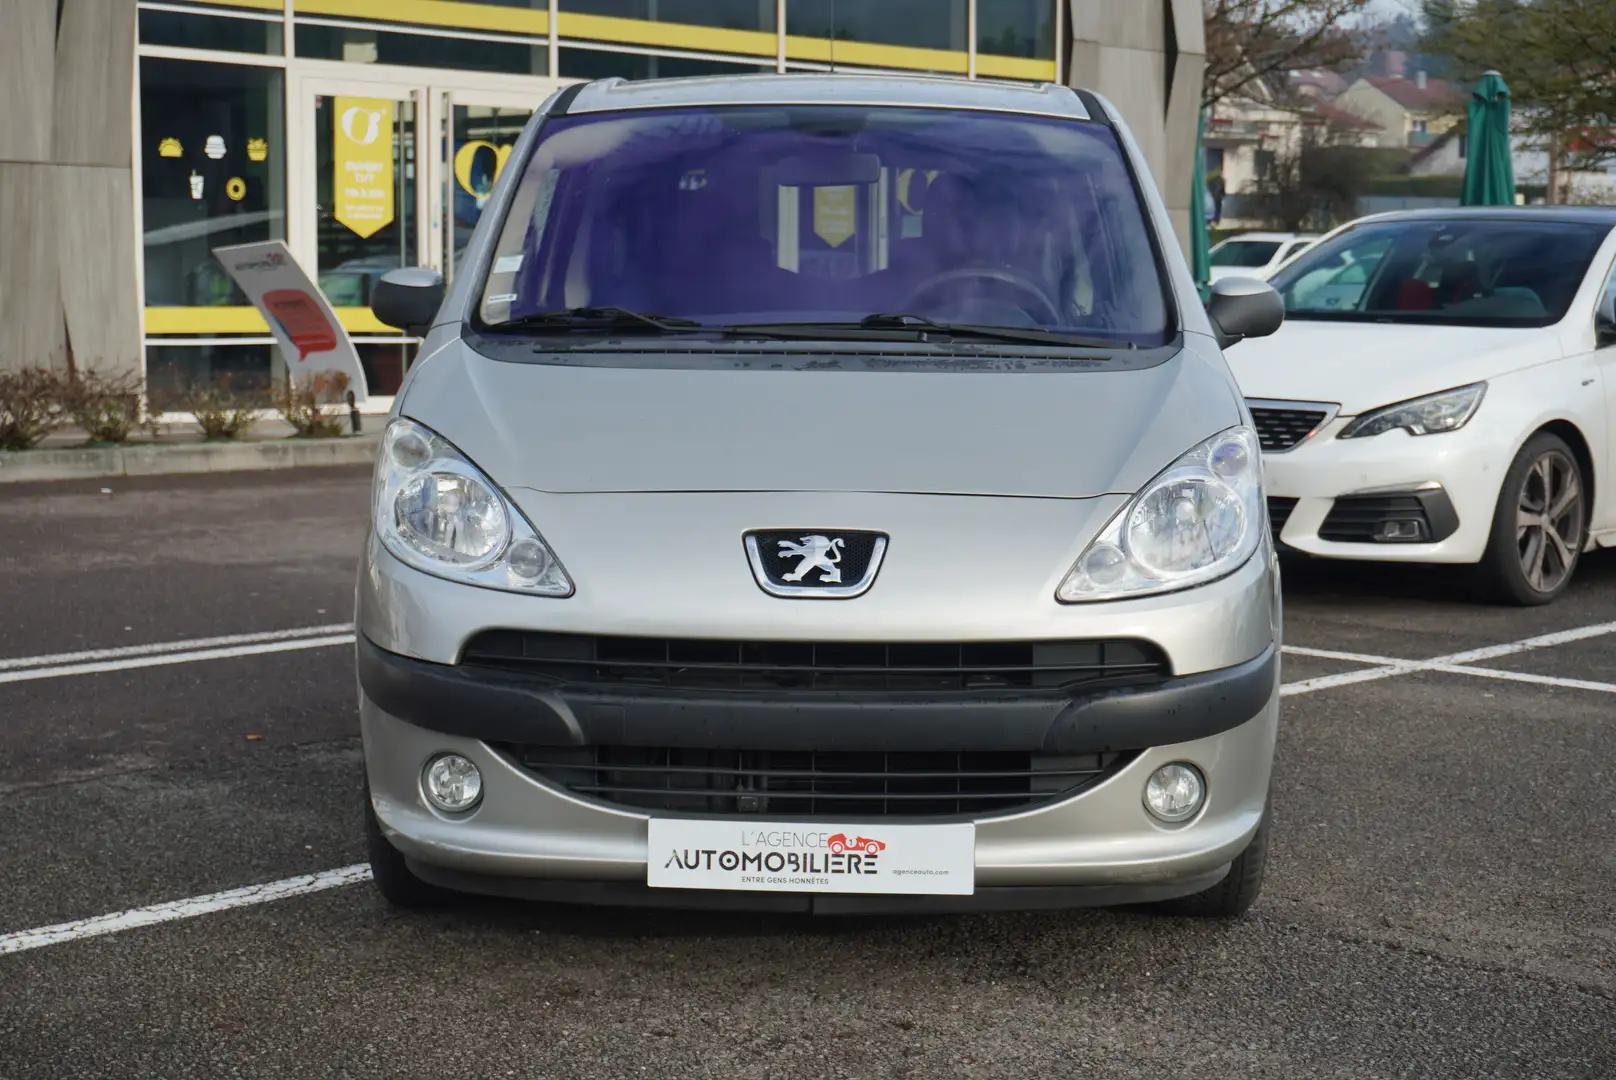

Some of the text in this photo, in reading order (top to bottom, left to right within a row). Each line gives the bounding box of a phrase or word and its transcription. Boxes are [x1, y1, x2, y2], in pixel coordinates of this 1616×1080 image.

[741, 830, 828, 848] L'AGENCE
[892, 868, 950, 877] agenceauto.com
[741, 876, 765, 884] ENTRE
[766, 877, 788, 885] GENS
